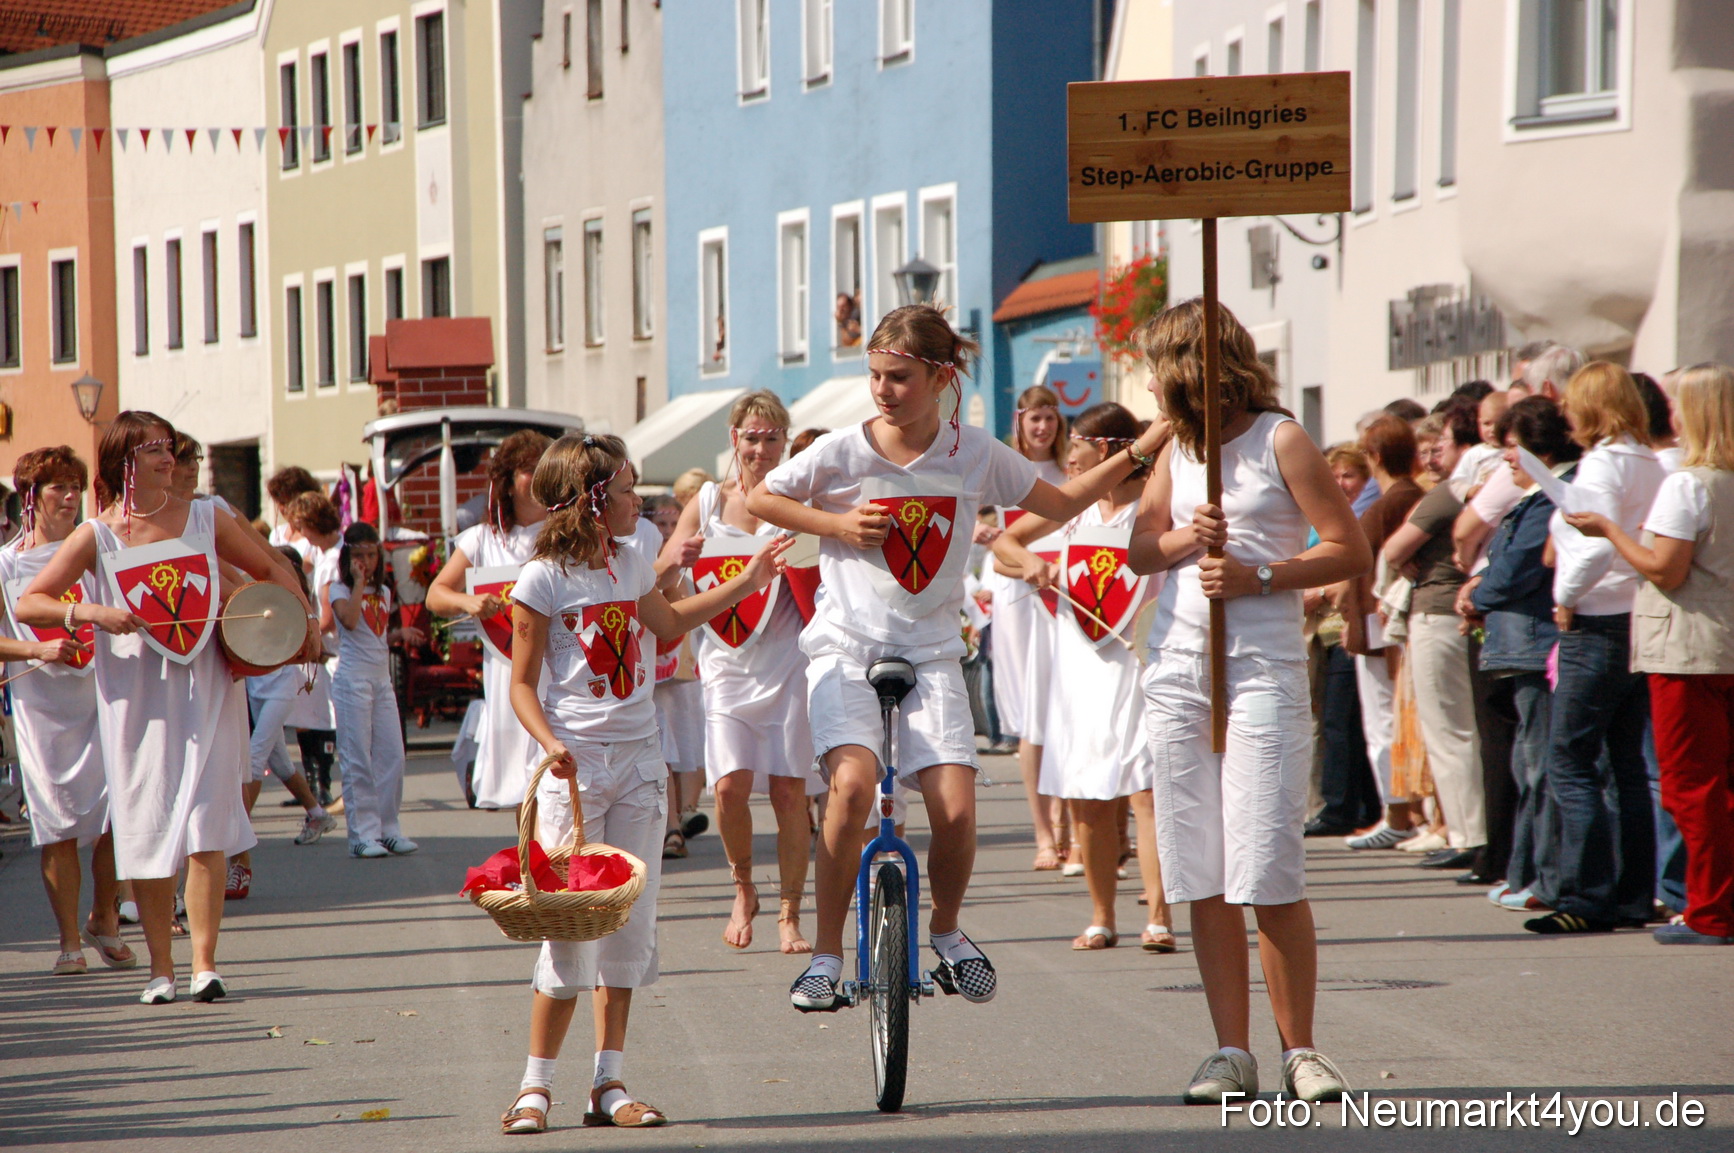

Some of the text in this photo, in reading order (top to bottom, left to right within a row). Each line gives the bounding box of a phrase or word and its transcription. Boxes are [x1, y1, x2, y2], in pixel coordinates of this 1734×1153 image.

[1118, 104, 1308, 132] 1. FC Beilngries
[1080, 158, 1335, 190] Step-Aerobic-Gruppe
